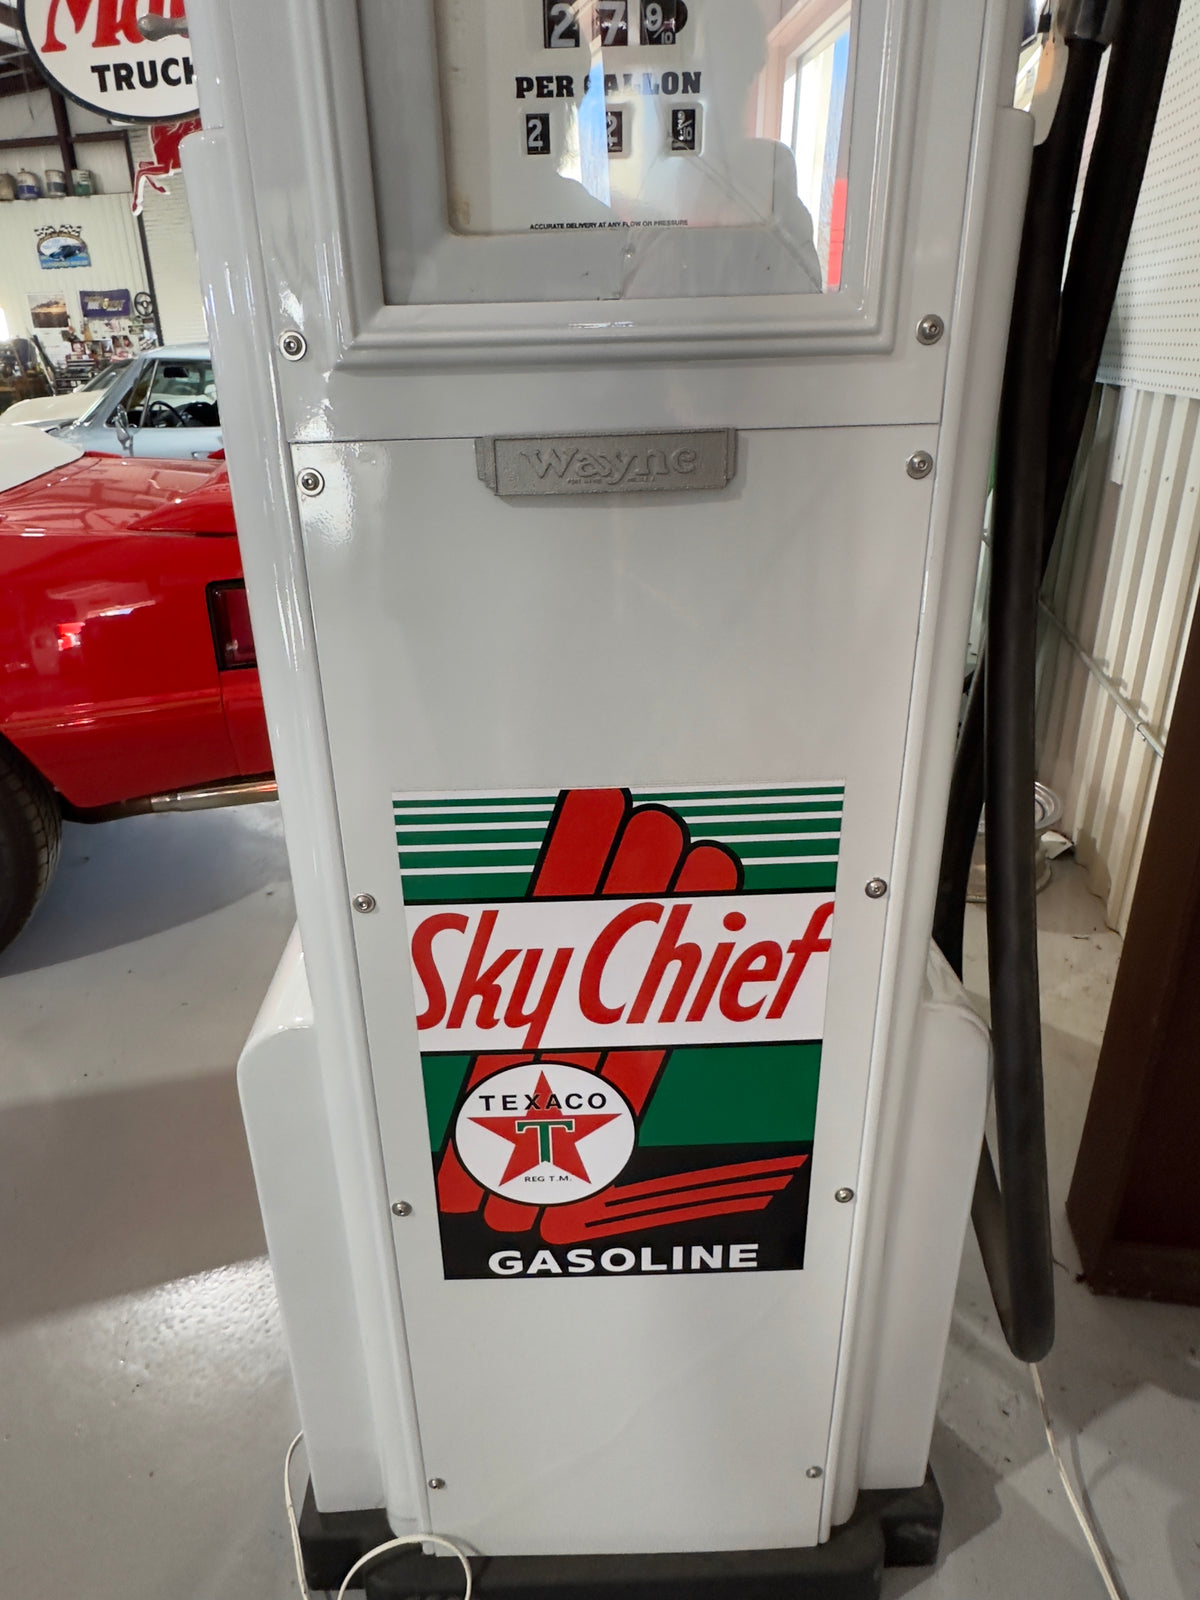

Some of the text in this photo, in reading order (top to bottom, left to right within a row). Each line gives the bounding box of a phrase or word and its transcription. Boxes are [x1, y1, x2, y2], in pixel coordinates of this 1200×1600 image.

[551, 2, 576, 48] 2
[598, 0, 626, 45] 7
[515, 75, 574, 98] PER
[527, 118, 543, 147] 2
[653, 219, 688, 227] PRESSURE
[520, 447, 697, 486] Wayne
[411, 901, 835, 1050] Sky Chief
[479, 1093, 607, 1111] TEXACO
[515, 1119, 575, 1164] T
[524, 1175, 545, 1183] REG
[488, 1243, 759, 1275] GASOLINE
